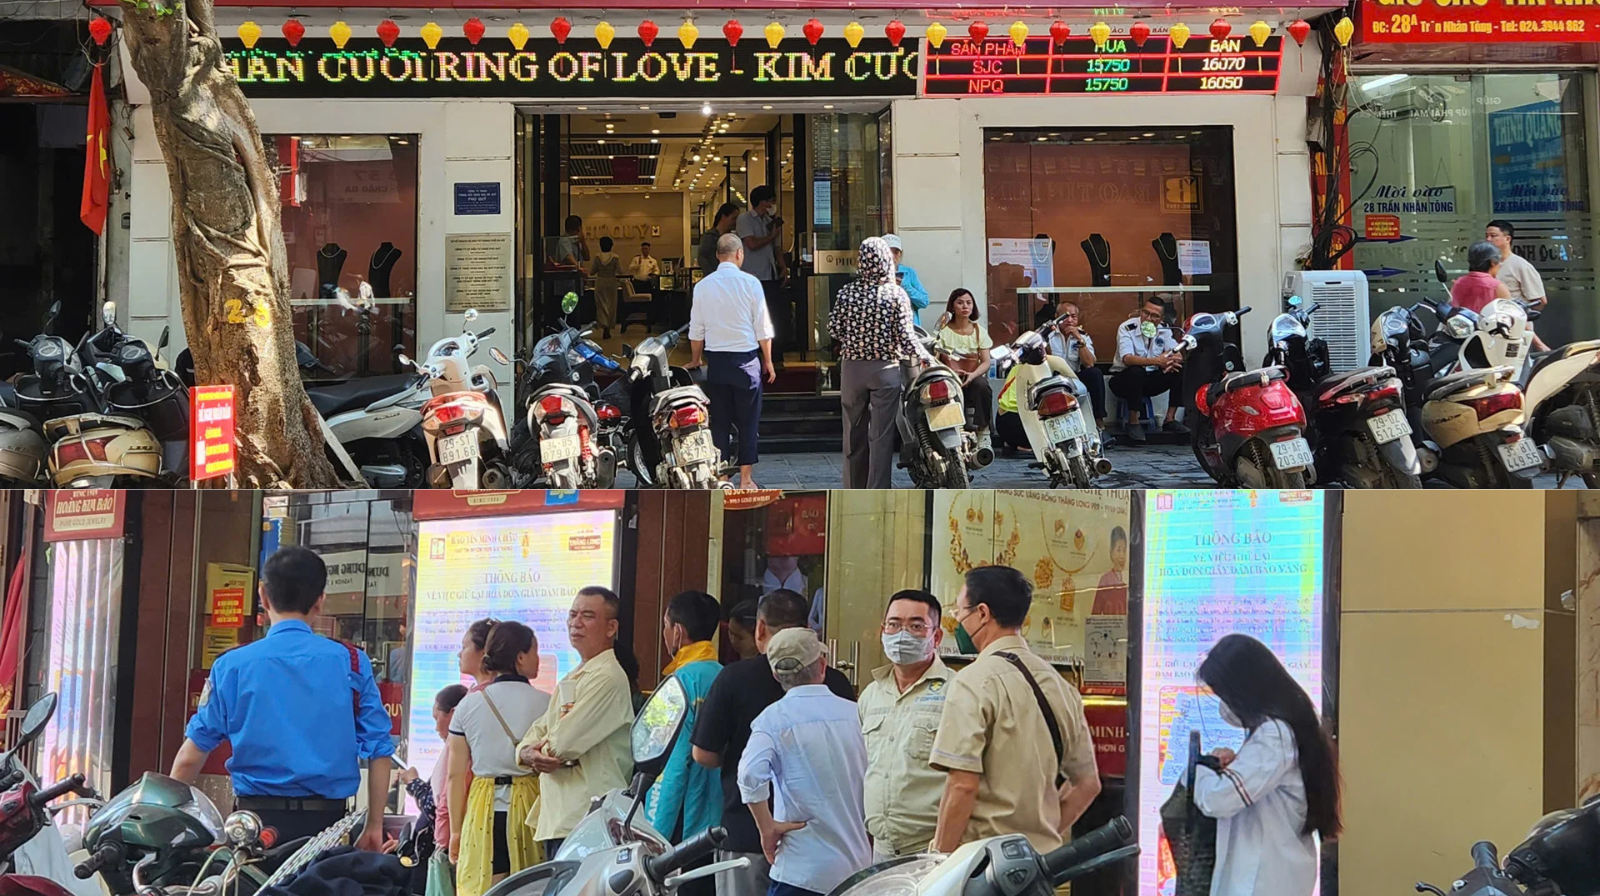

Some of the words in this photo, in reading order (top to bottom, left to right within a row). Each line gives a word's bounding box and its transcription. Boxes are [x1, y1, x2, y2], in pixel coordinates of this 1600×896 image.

[1420, 20, 1442, 33] Trn
[1500, 20, 1518, 32] Tel:
[1566, 20, 1585, 32] 862
[434, 51, 539, 82] RING
[548, 51, 602, 82] OF
[612, 51, 721, 82] LOVE
[753, 51, 836, 82] KIM
[972, 60, 1003, 75] SJC
[1086, 59, 1131, 72] 15750
[1202, 58, 1246, 72] 16070
[968, 79, 1004, 93] NPQ
[1085, 78, 1129, 91] 15750
[1199, 77, 1243, 91] 16050
[1371, 184, 1406, 198] Mời
[1412, 184, 1443, 198] vào
[1364, 202, 1375, 213] 28
[1376, 422, 1409, 441] 512.50
[442, 445, 476, 463] 891.66
[1276, 440, 1302, 455] 29-AF
[1277, 452, 1311, 467] 203.90
[1506, 452, 1540, 469] 449.55
[56, 497, 82, 515] HOÀNG
[73, 518, 86, 526] GOLD
[1194, 531, 1240, 546] THÔNG
[1244, 529, 1272, 544] BÁO
[483, 569, 518, 584] THÔNG
[520, 568, 541, 583] BÁO
